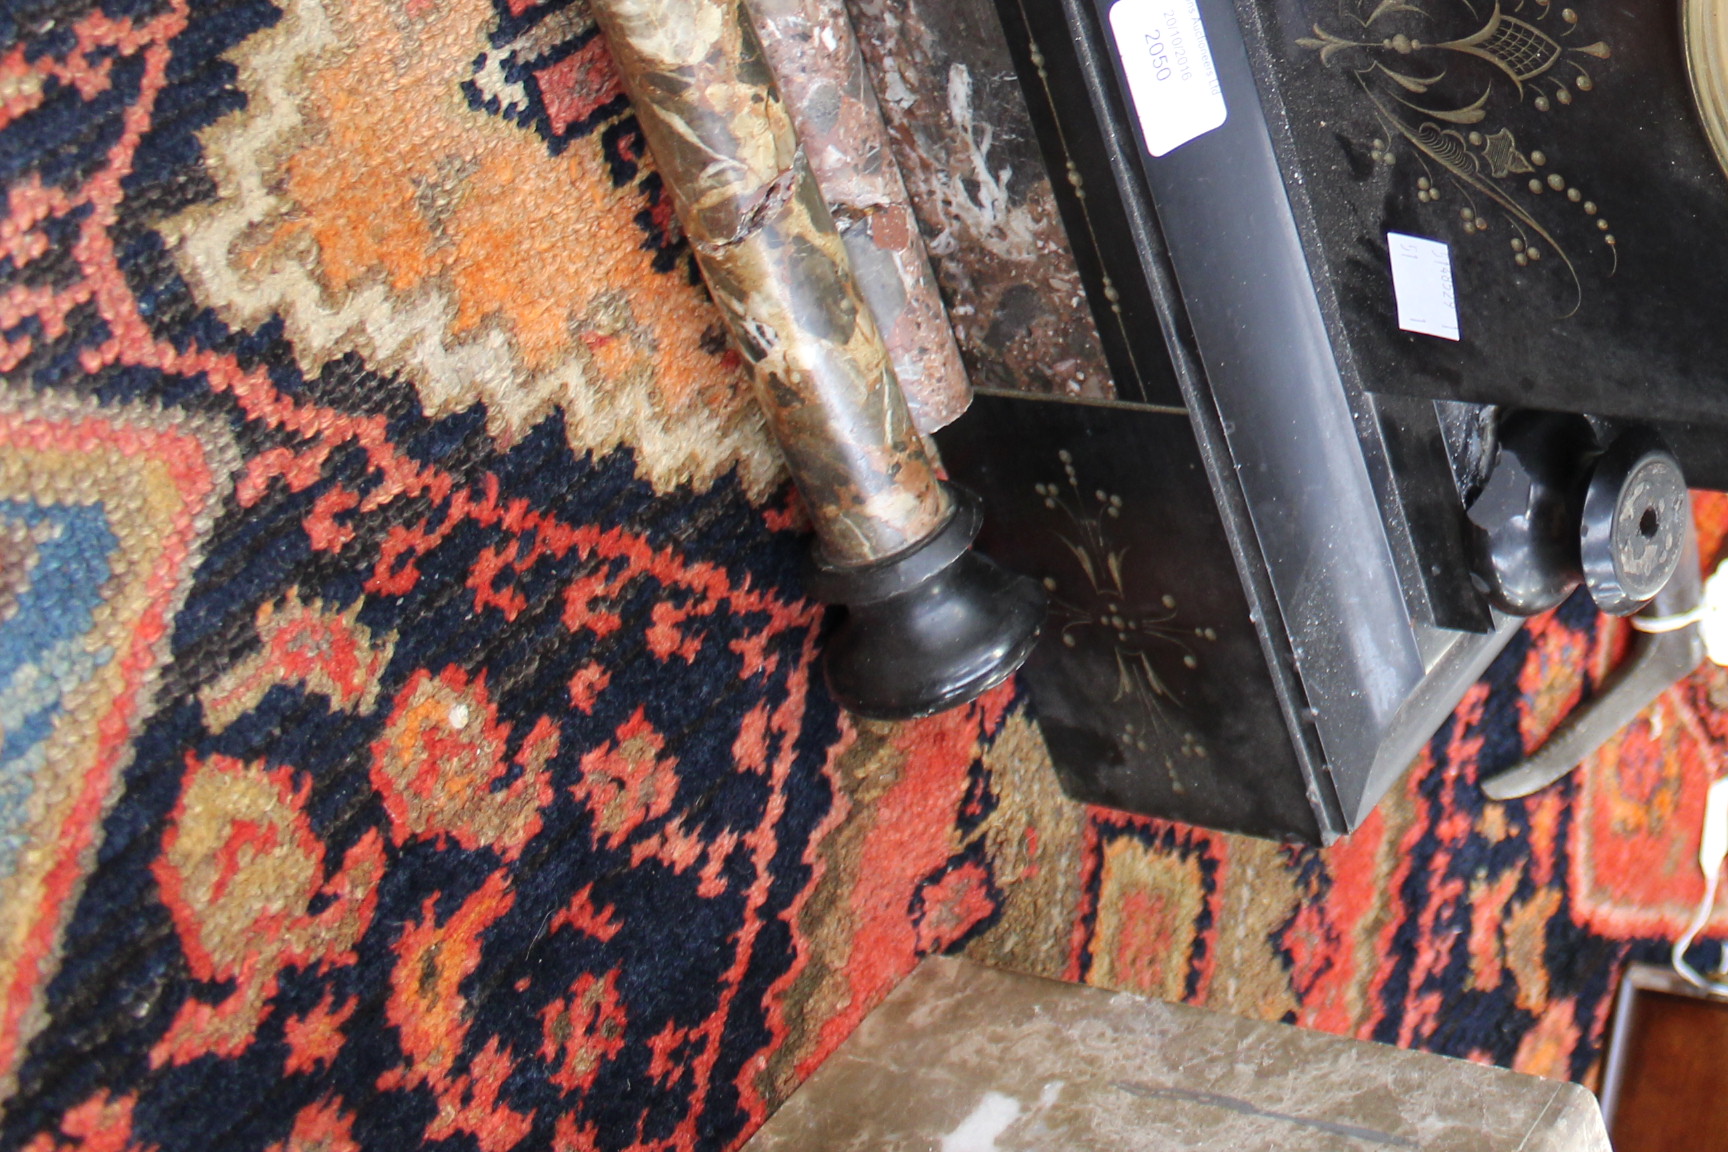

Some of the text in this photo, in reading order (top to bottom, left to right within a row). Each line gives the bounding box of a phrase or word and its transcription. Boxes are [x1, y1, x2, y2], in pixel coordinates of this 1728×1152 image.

[1144, 29, 1172, 82] 2050
[1163, 9, 1192, 82] 20/10/2016
[1191, 15, 1215, 78] Auctioneers
[1209, 78, 1222, 96] Ltd
